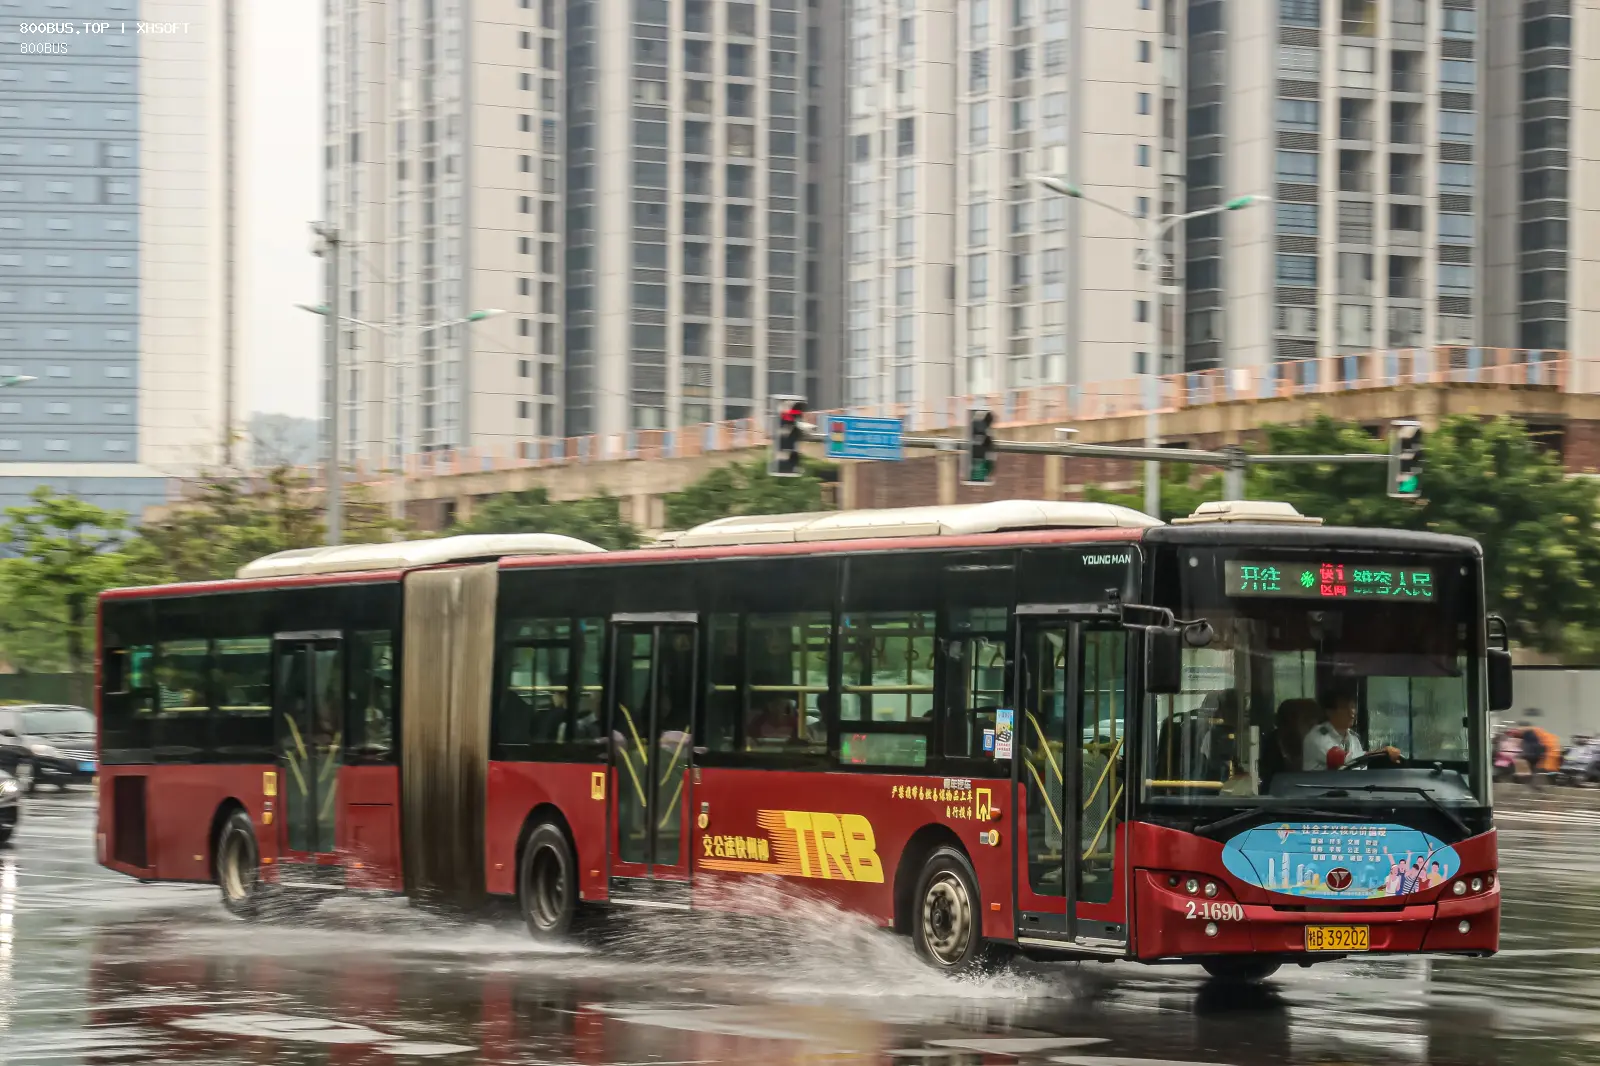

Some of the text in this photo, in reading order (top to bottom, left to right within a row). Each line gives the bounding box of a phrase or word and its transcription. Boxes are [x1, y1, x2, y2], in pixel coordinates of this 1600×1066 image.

[1082, 554, 1132, 565] YOUNG MAN
[1240, 565, 1281, 591] 开往
[891, 785, 974, 803] 严禁携带易燃易爆物品上车
[945, 805, 973, 820] 自行投币
[1302, 825, 1387, 837] 社会主义核心价值观
[784, 811, 885, 883] TRB
[1186, 901, 1243, 921] 2-1690
